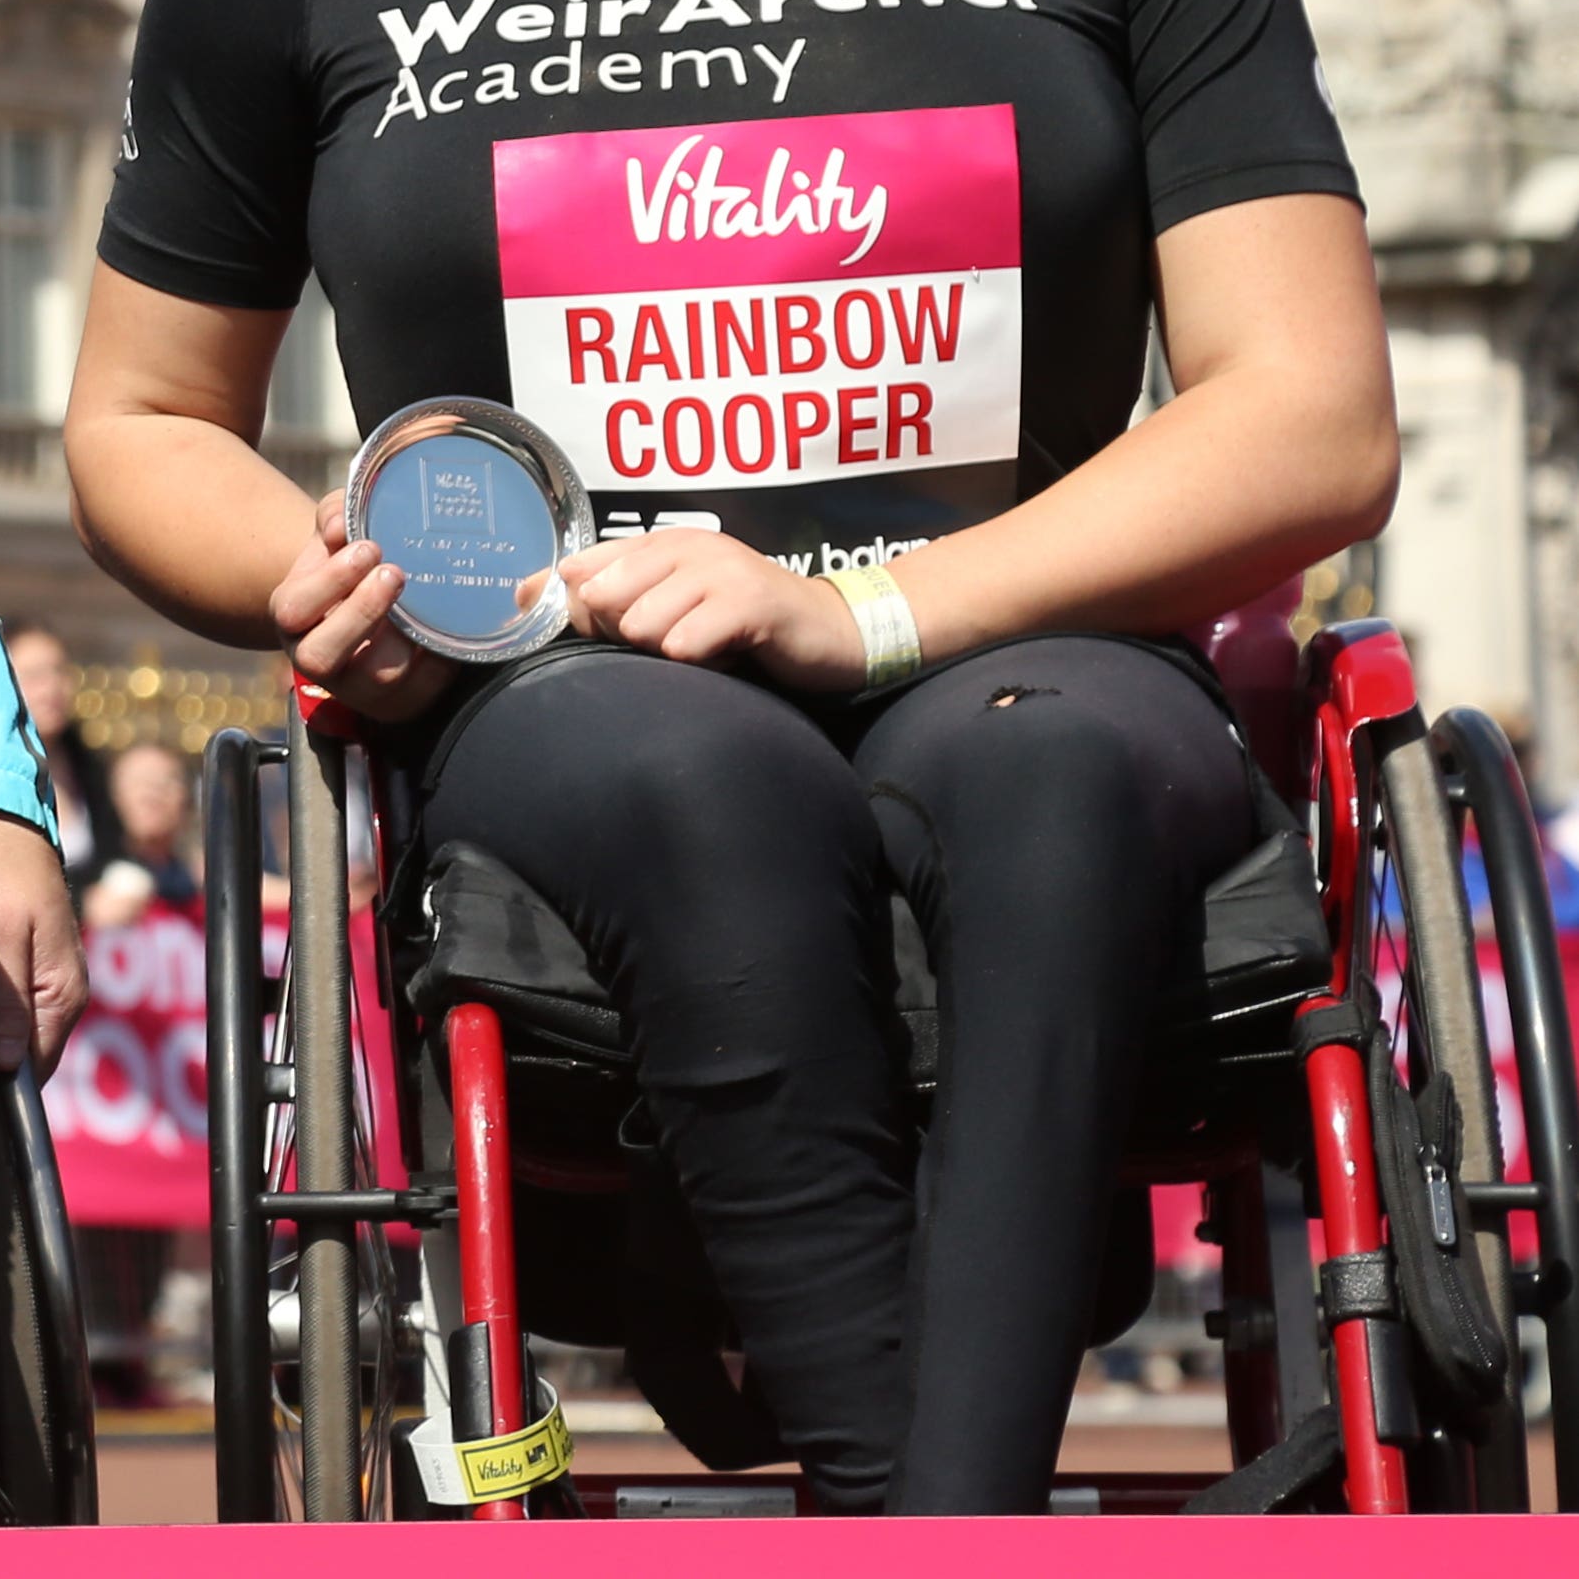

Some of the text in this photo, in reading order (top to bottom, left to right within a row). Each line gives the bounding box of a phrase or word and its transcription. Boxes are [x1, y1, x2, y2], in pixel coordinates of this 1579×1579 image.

[373, 37, 807, 138] Academy
[626, 134, 888, 266] Vitality
[565, 283, 965, 385] RAINBOW
[605, 381, 934, 478] COOPER
[477, 1456, 523, 1482] Vitality
